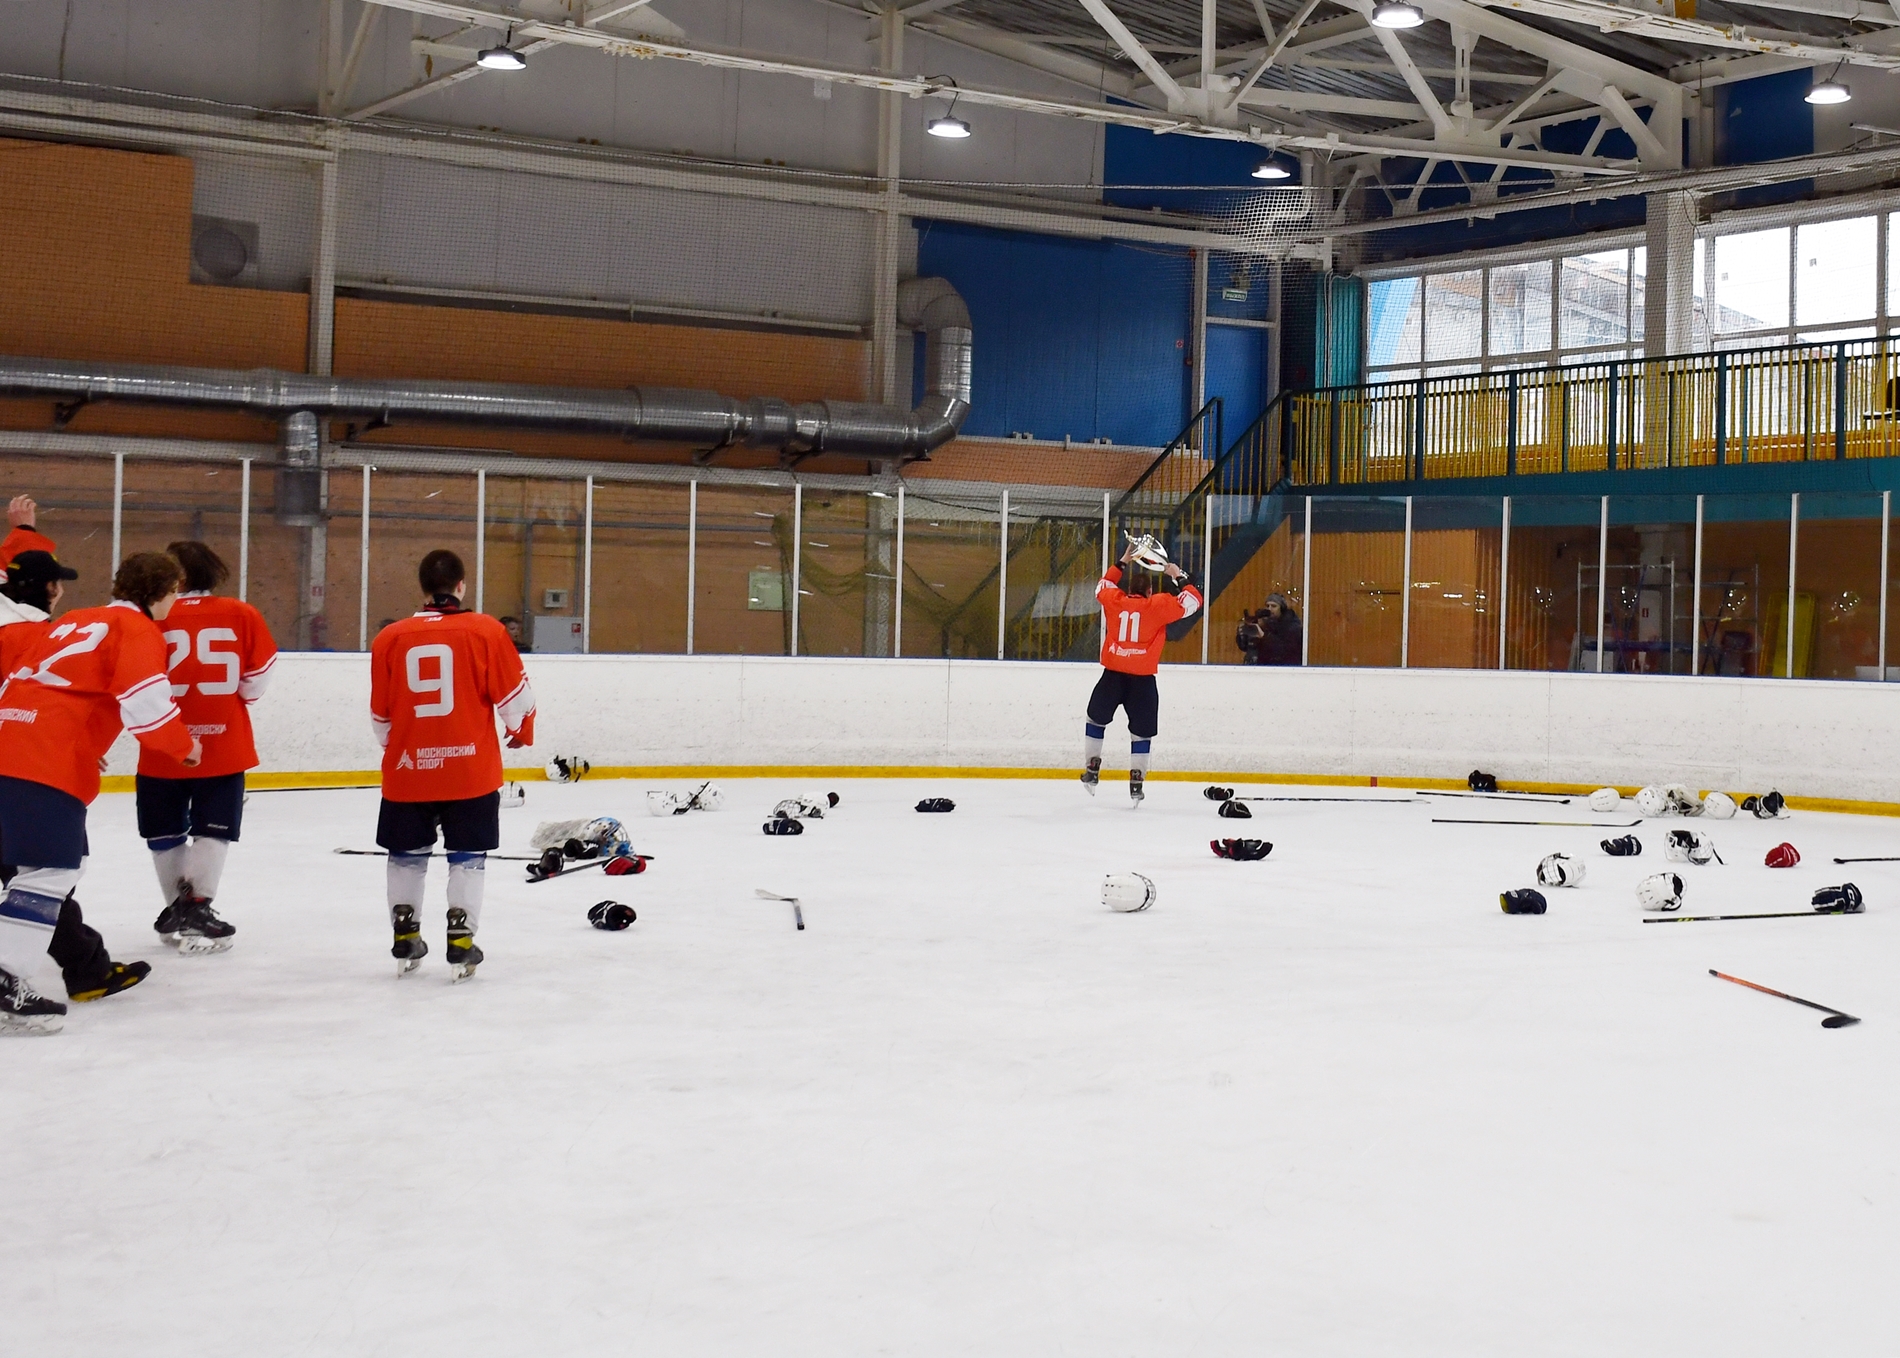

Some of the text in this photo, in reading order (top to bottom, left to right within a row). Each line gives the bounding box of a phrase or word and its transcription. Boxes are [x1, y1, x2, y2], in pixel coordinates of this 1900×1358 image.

[1119, 611, 1141, 643] 11
[163, 628, 240, 697] 25
[406, 644, 454, 718] 9
[417, 742, 476, 759] МОСКОВСКИЙ
[417, 758, 445, 770] СПОРТ
